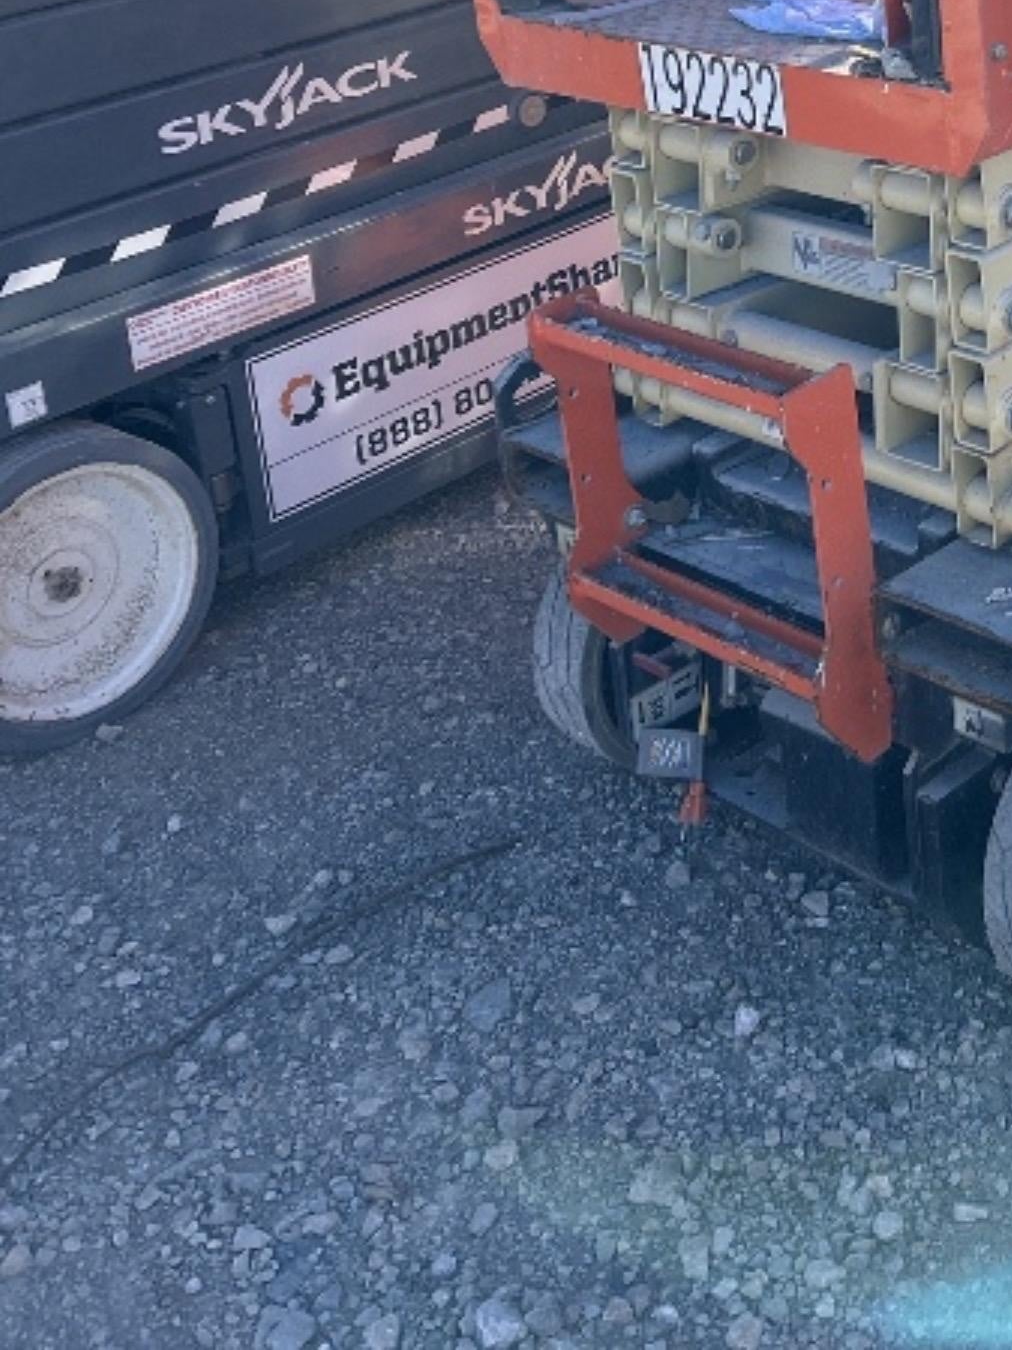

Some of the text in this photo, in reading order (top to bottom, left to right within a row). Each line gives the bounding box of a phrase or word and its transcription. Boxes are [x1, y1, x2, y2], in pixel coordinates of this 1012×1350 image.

[158, 51, 418, 155] SKYJACK
[641, 42, 784, 136] 192232
[356, 399, 443, 465] (888)
